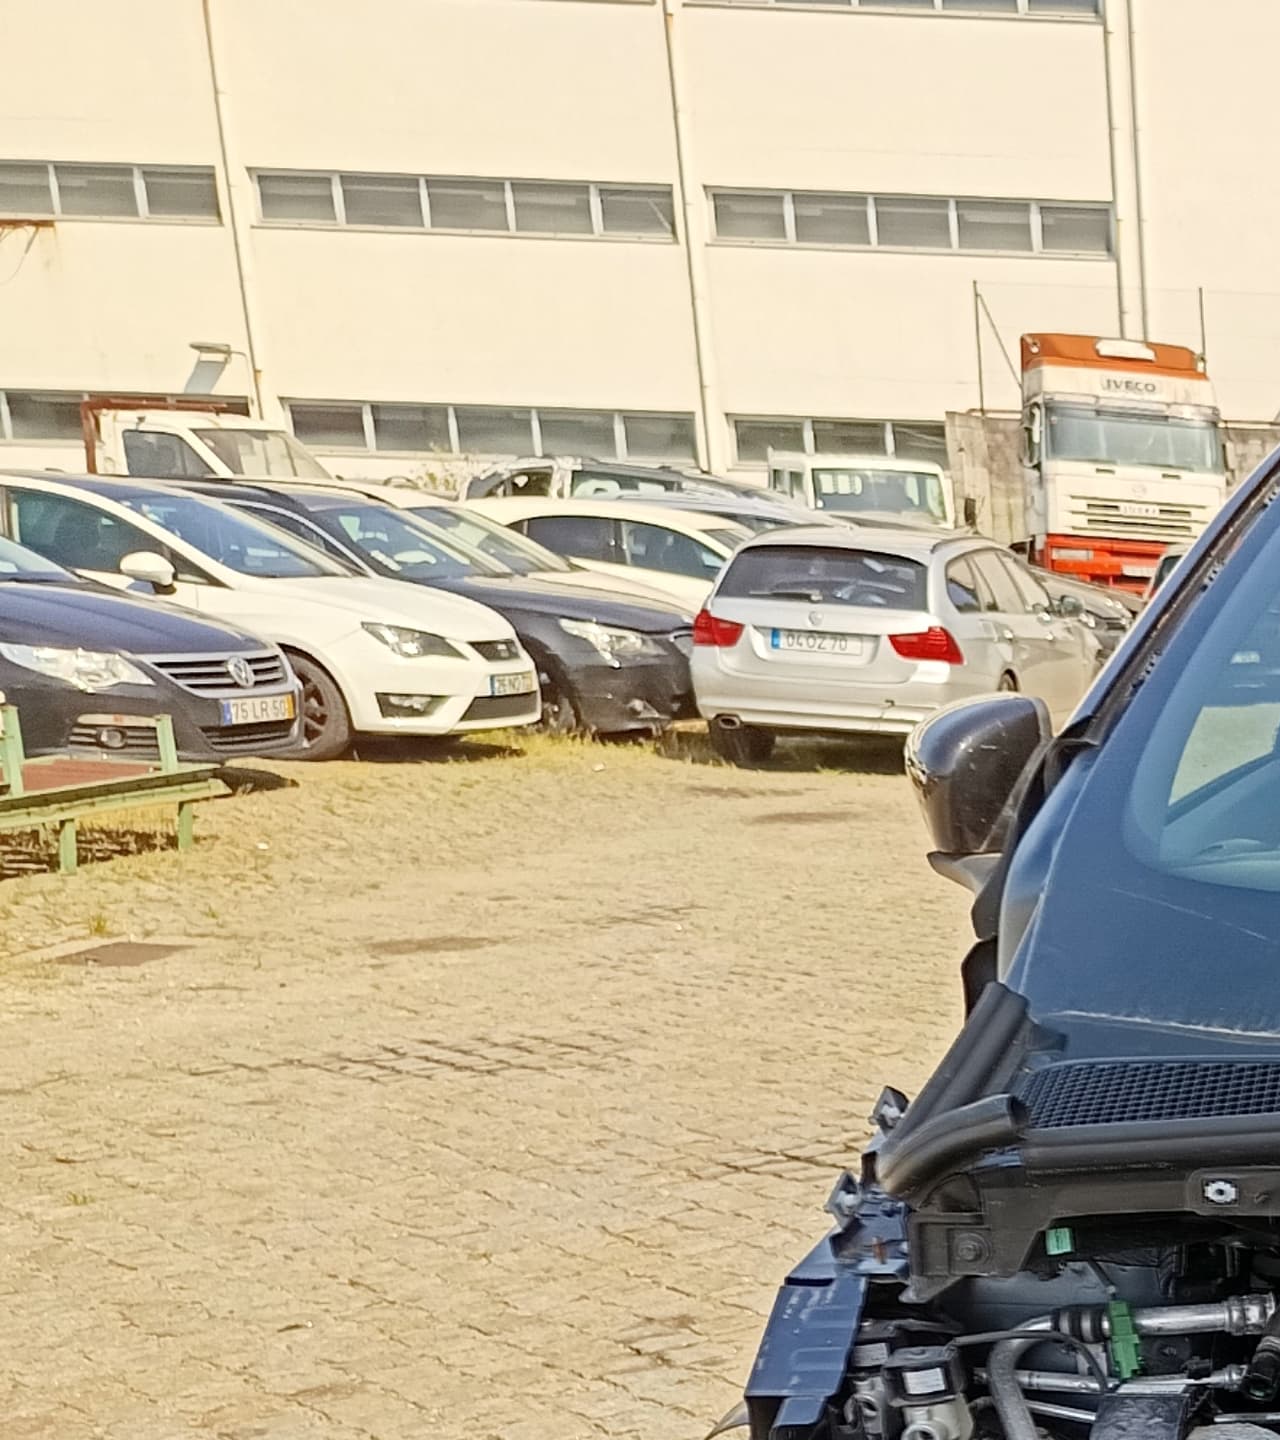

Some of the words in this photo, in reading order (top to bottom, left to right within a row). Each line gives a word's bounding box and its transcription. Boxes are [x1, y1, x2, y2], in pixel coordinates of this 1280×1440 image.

[1106, 378, 1157, 393] IVECO
[786, 633, 803, 647] 04
[232, 702, 249, 722] 75
[252, 700, 270, 720] LR
